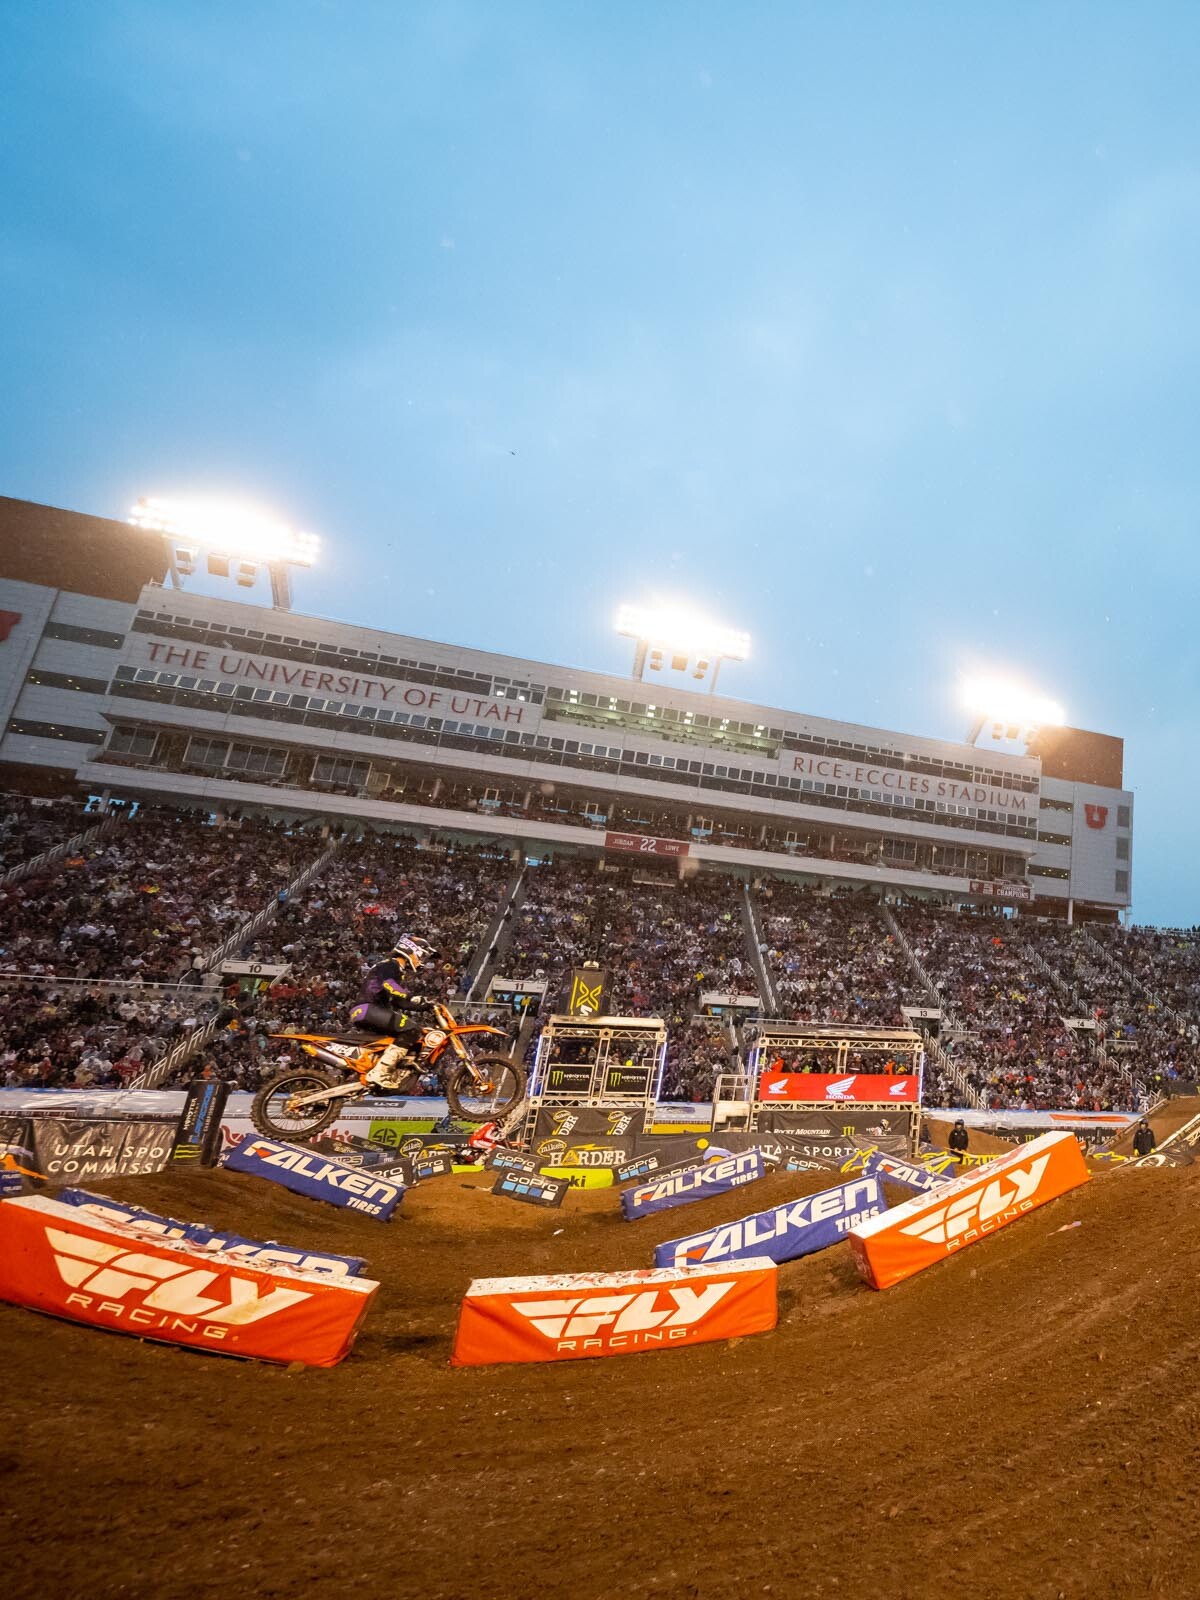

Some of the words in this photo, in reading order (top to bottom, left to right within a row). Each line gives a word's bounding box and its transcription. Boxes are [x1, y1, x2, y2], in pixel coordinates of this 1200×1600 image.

[148, 641, 209, 670] THE
[220, 655, 396, 701] UNIVERSITY
[404, 688, 442, 708] OF
[451, 696, 523, 724] UTAH
[793, 756, 929, 793] RICE-ECCLES
[937, 782, 1026, 810] STADIUM
[639, 838, 657, 852] 22
[996, 888, 1028, 899] CHAMPIONS
[248, 964, 262, 973] 10
[54, 1144, 114, 1157] UTAH
[122, 1146, 172, 1159] SPO
[495, 1152, 536, 1168] GoPro
[548, 1150, 626, 1167] HARDER
[242, 1140, 398, 1205] FALKEN
[618, 1157, 657, 1174] GoPro
[506, 1172, 559, 1192] GoPro
[633, 1152, 758, 1207] FALKEN
[731, 1170, 758, 1187] TIRES
[346, 1197, 382, 1215] TIRES
[898, 1152, 1051, 1244] FLY
[674, 1178, 878, 1268] FALKEN
[835, 1206, 880, 1233] TIRES
[946, 1200, 1033, 1251] RACING
[44, 1226, 314, 1326] FLY
[66, 1292, 229, 1340] RACING
[510, 1281, 737, 1339] FLY
[557, 1328, 688, 1352] RACING
